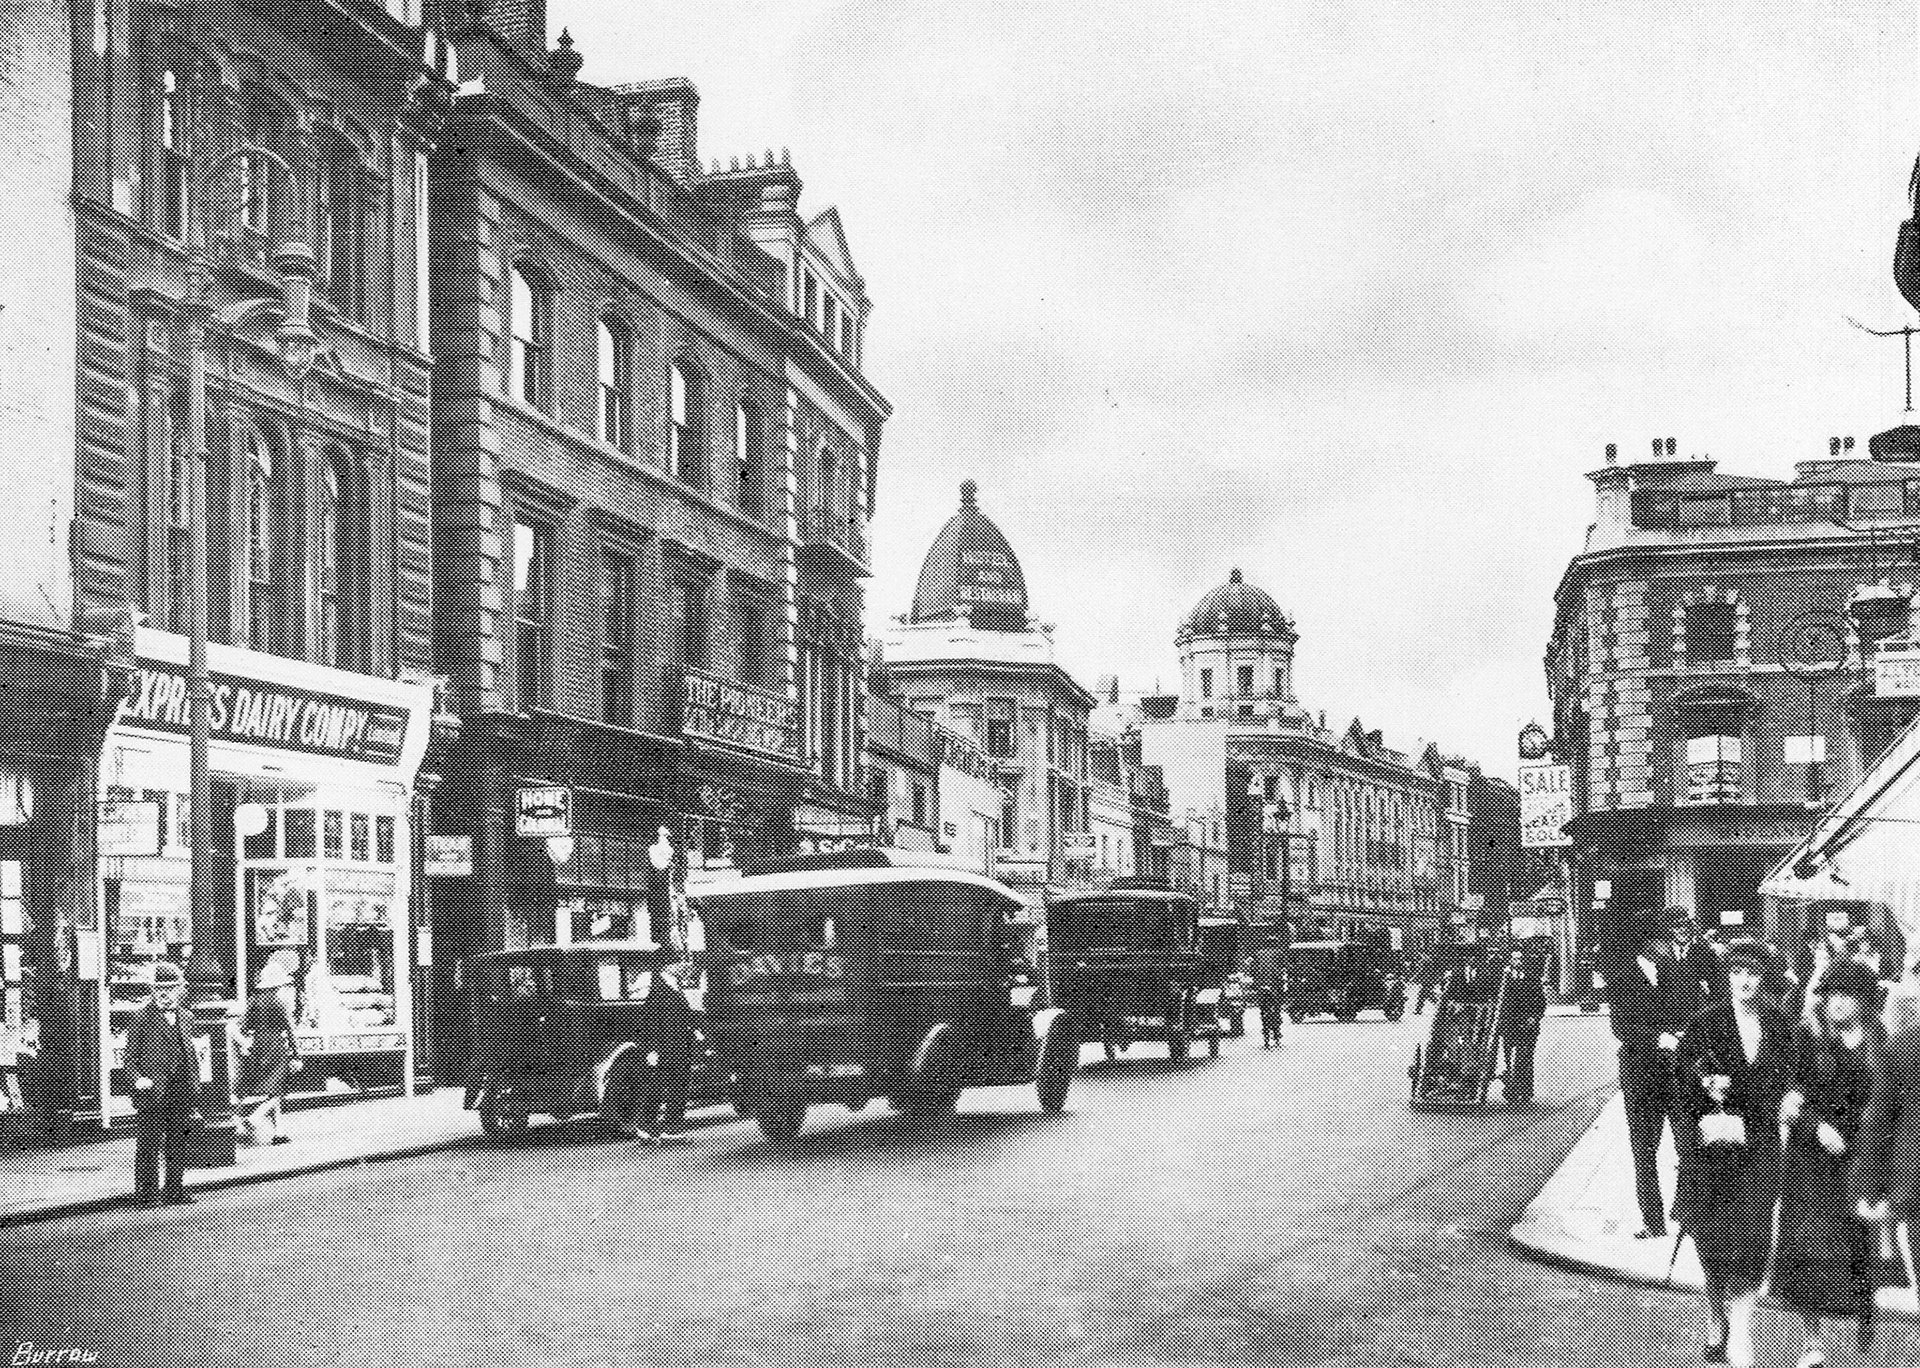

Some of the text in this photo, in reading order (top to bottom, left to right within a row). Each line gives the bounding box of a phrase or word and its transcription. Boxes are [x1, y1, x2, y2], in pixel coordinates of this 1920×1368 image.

[116, 669, 231, 730] EXPRS
[231, 688, 302, 741] DAIRY
[684, 675, 719, 709] THE
[720, 684, 798, 730] PIONEERS
[1523, 769, 1569, 795] SALE
[520, 790, 567, 810] HOME
[1525, 827, 1568, 844] SOLD
[729, 951, 844, 985] DAVIES
